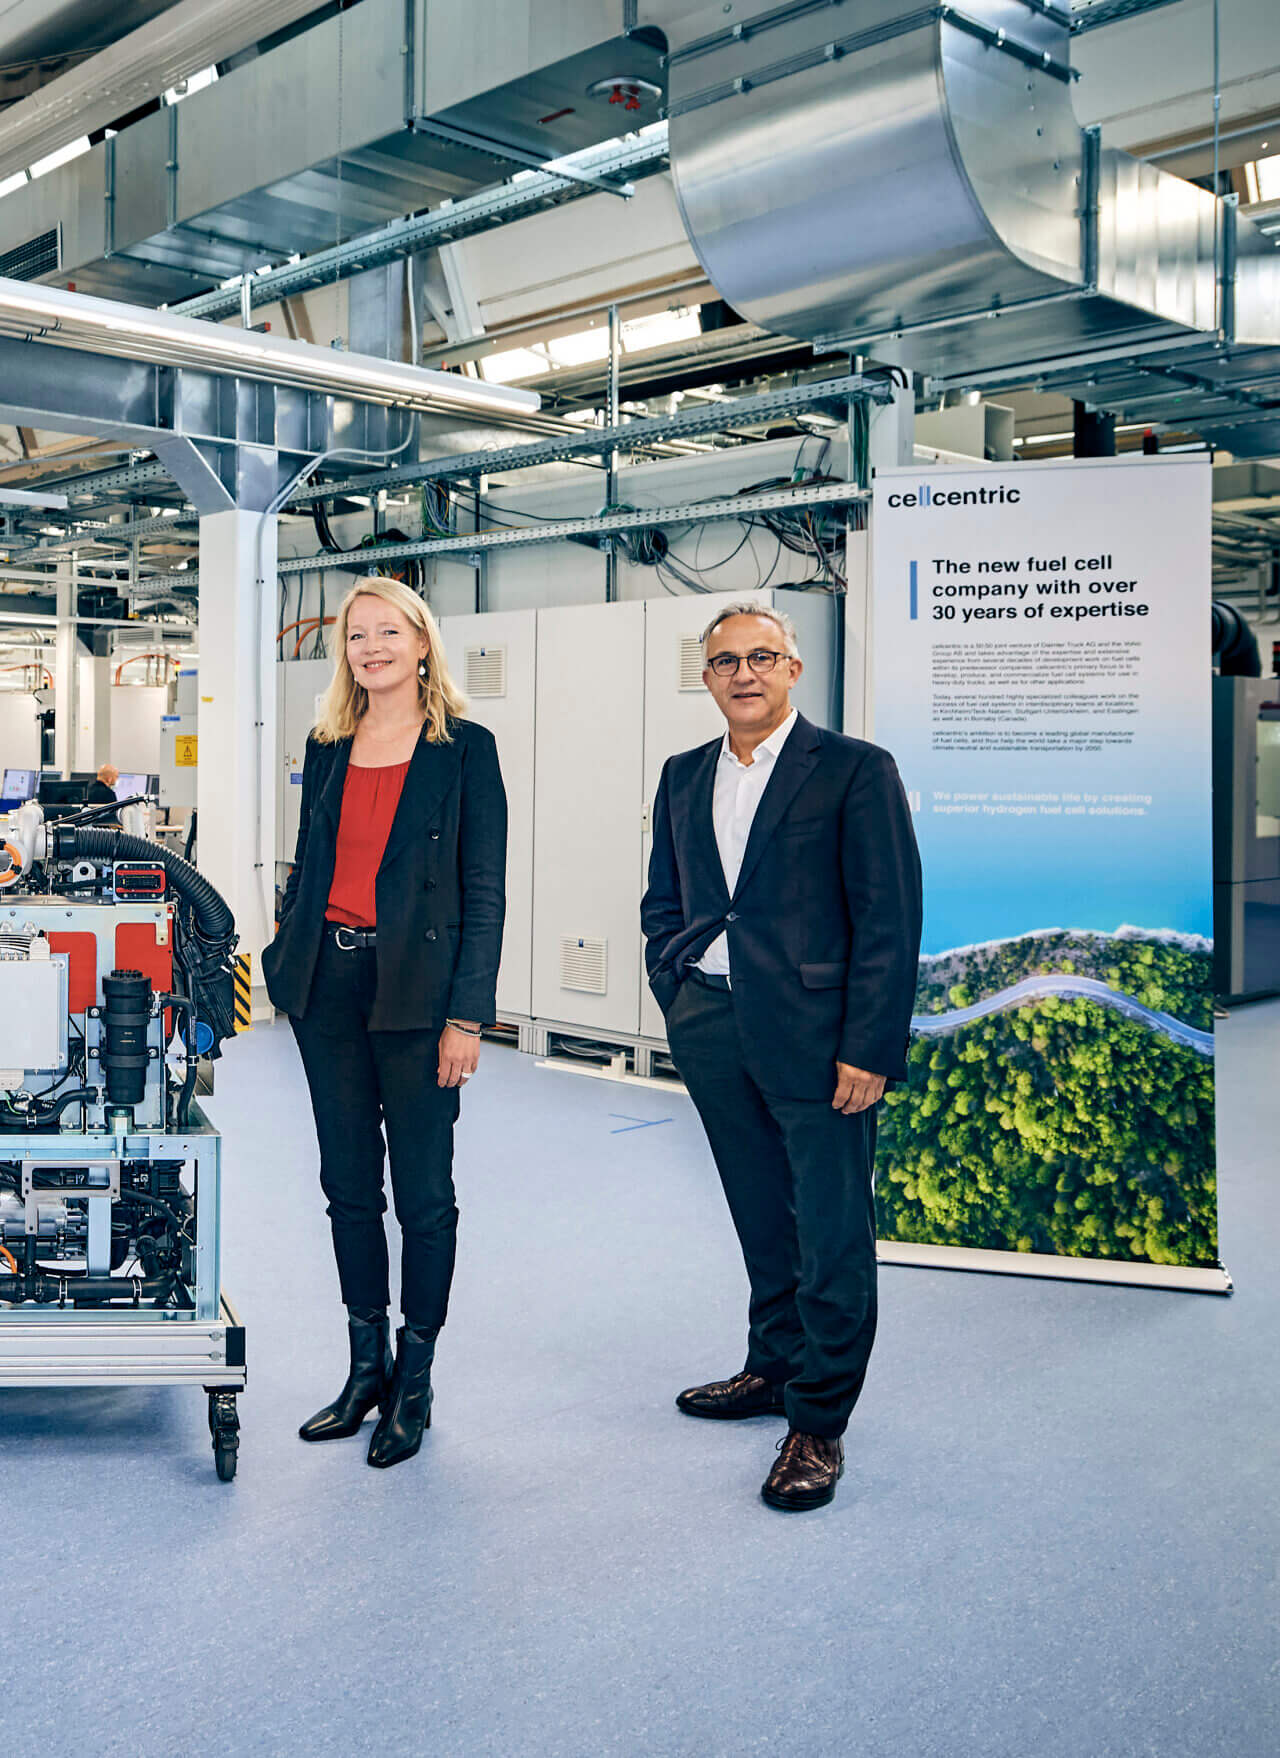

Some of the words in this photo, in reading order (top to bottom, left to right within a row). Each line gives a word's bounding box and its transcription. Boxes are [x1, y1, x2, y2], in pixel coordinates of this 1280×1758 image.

[888, 485, 1021, 508] cellcentric
[932, 560, 970, 574] The
[978, 561, 1020, 573] new
[1028, 556, 1066, 572] fuel
[1074, 554, 1112, 570] cell
[933, 584, 1028, 600] company
[1036, 580, 1080, 594] with
[1089, 581, 1137, 593] over
[933, 605, 955, 620] 30
[962, 608, 1017, 623] years
[1024, 603, 1044, 618] of
[1050, 601, 1149, 621] expertise
[992, 793, 1059, 801] sustainable
[1101, 794, 1152, 803] creating
[933, 804, 980, 814] superior
[982, 805, 1037, 815] hydrogen
